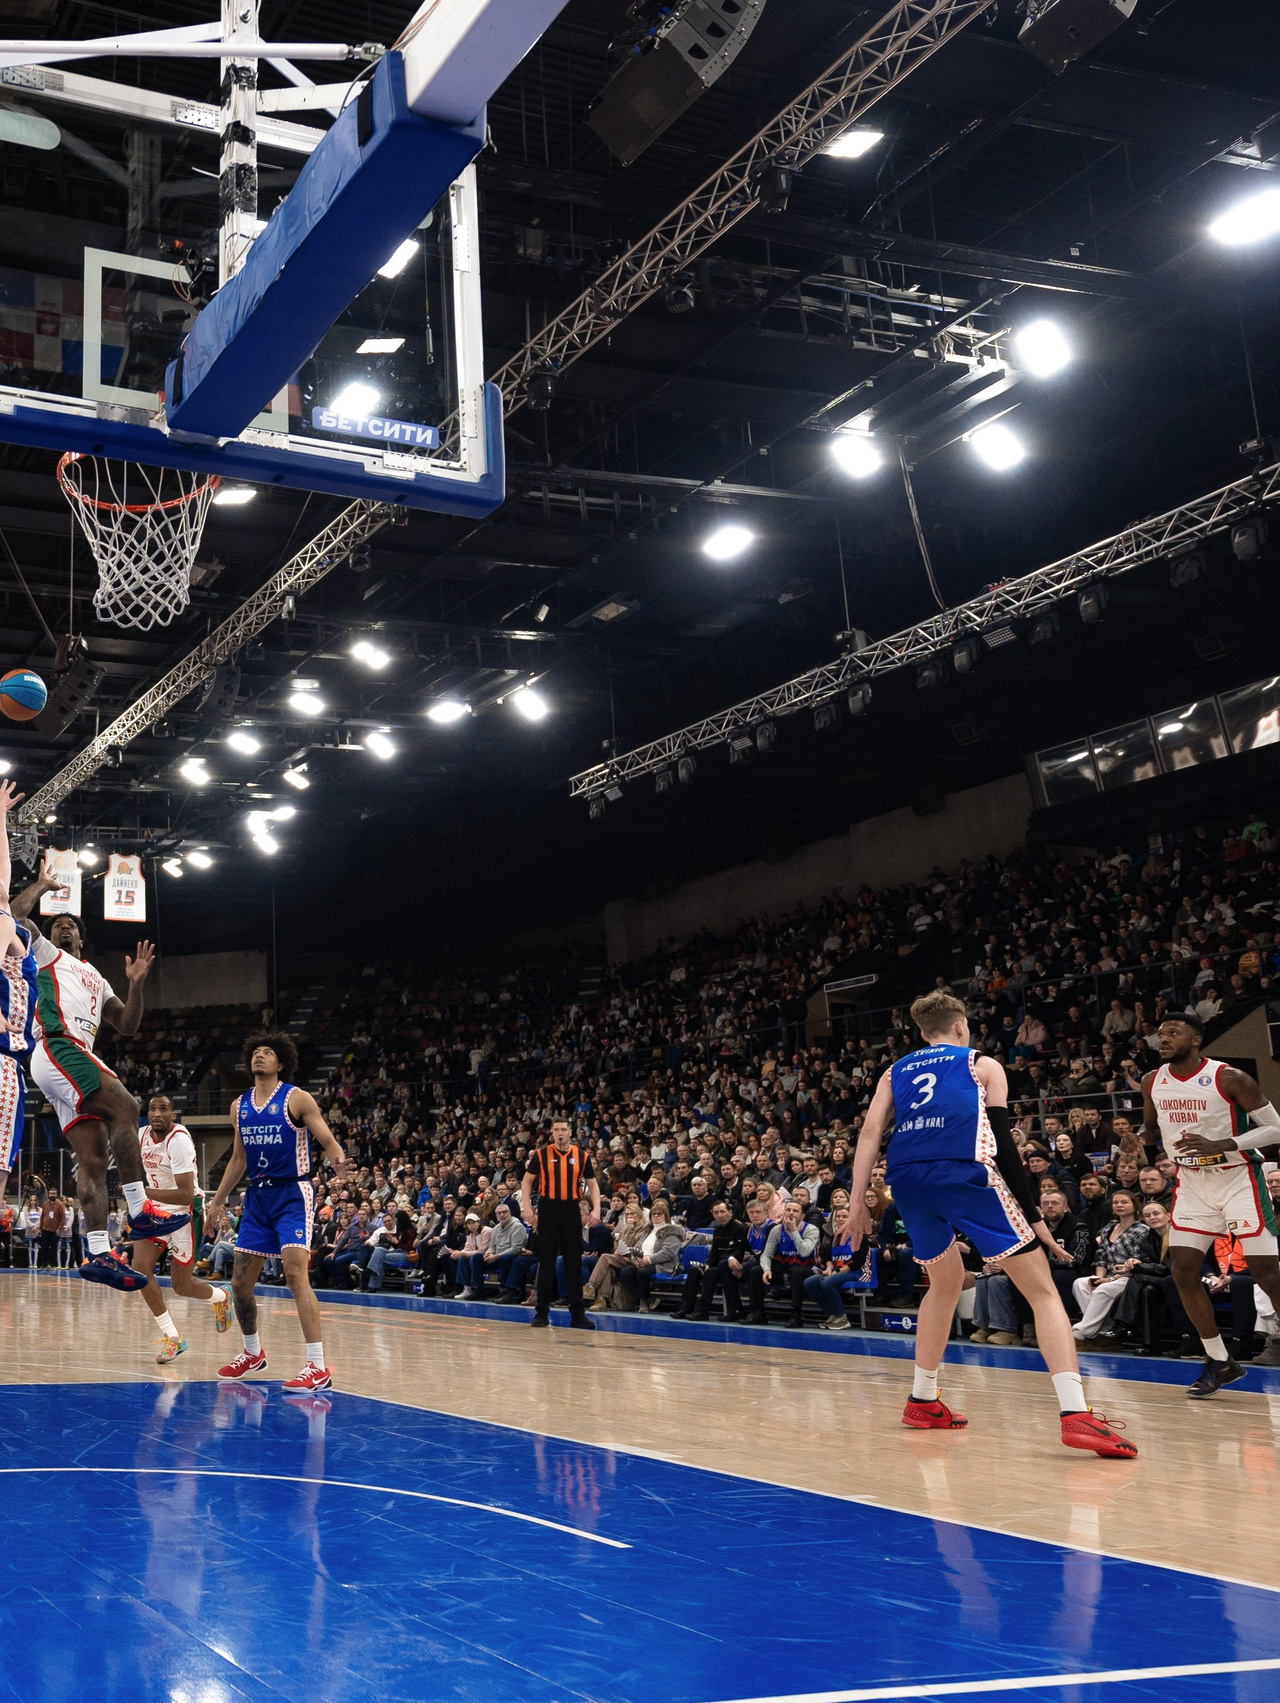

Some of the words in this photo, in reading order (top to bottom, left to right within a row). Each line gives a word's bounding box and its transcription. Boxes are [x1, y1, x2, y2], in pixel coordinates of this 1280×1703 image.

[319, 411, 433, 445] БЕТСИТИ
[112, 877, 138, 888] ДАЙНЕКО
[50, 885, 71, 901] 13
[114, 889, 135, 906] 15
[91, 995, 97, 1017] 2
[910, 1072, 937, 1110] 3
[1159, 1099, 1207, 1111] LOKOMOTIV
[1169, 1112, 1198, 1123] KUBAN
[241, 1124, 283, 1135] BETCITY
[242, 1134, 283, 1146] PARMA
[257, 1151, 269, 1168] 6
[150, 1173, 159, 1188] 5
